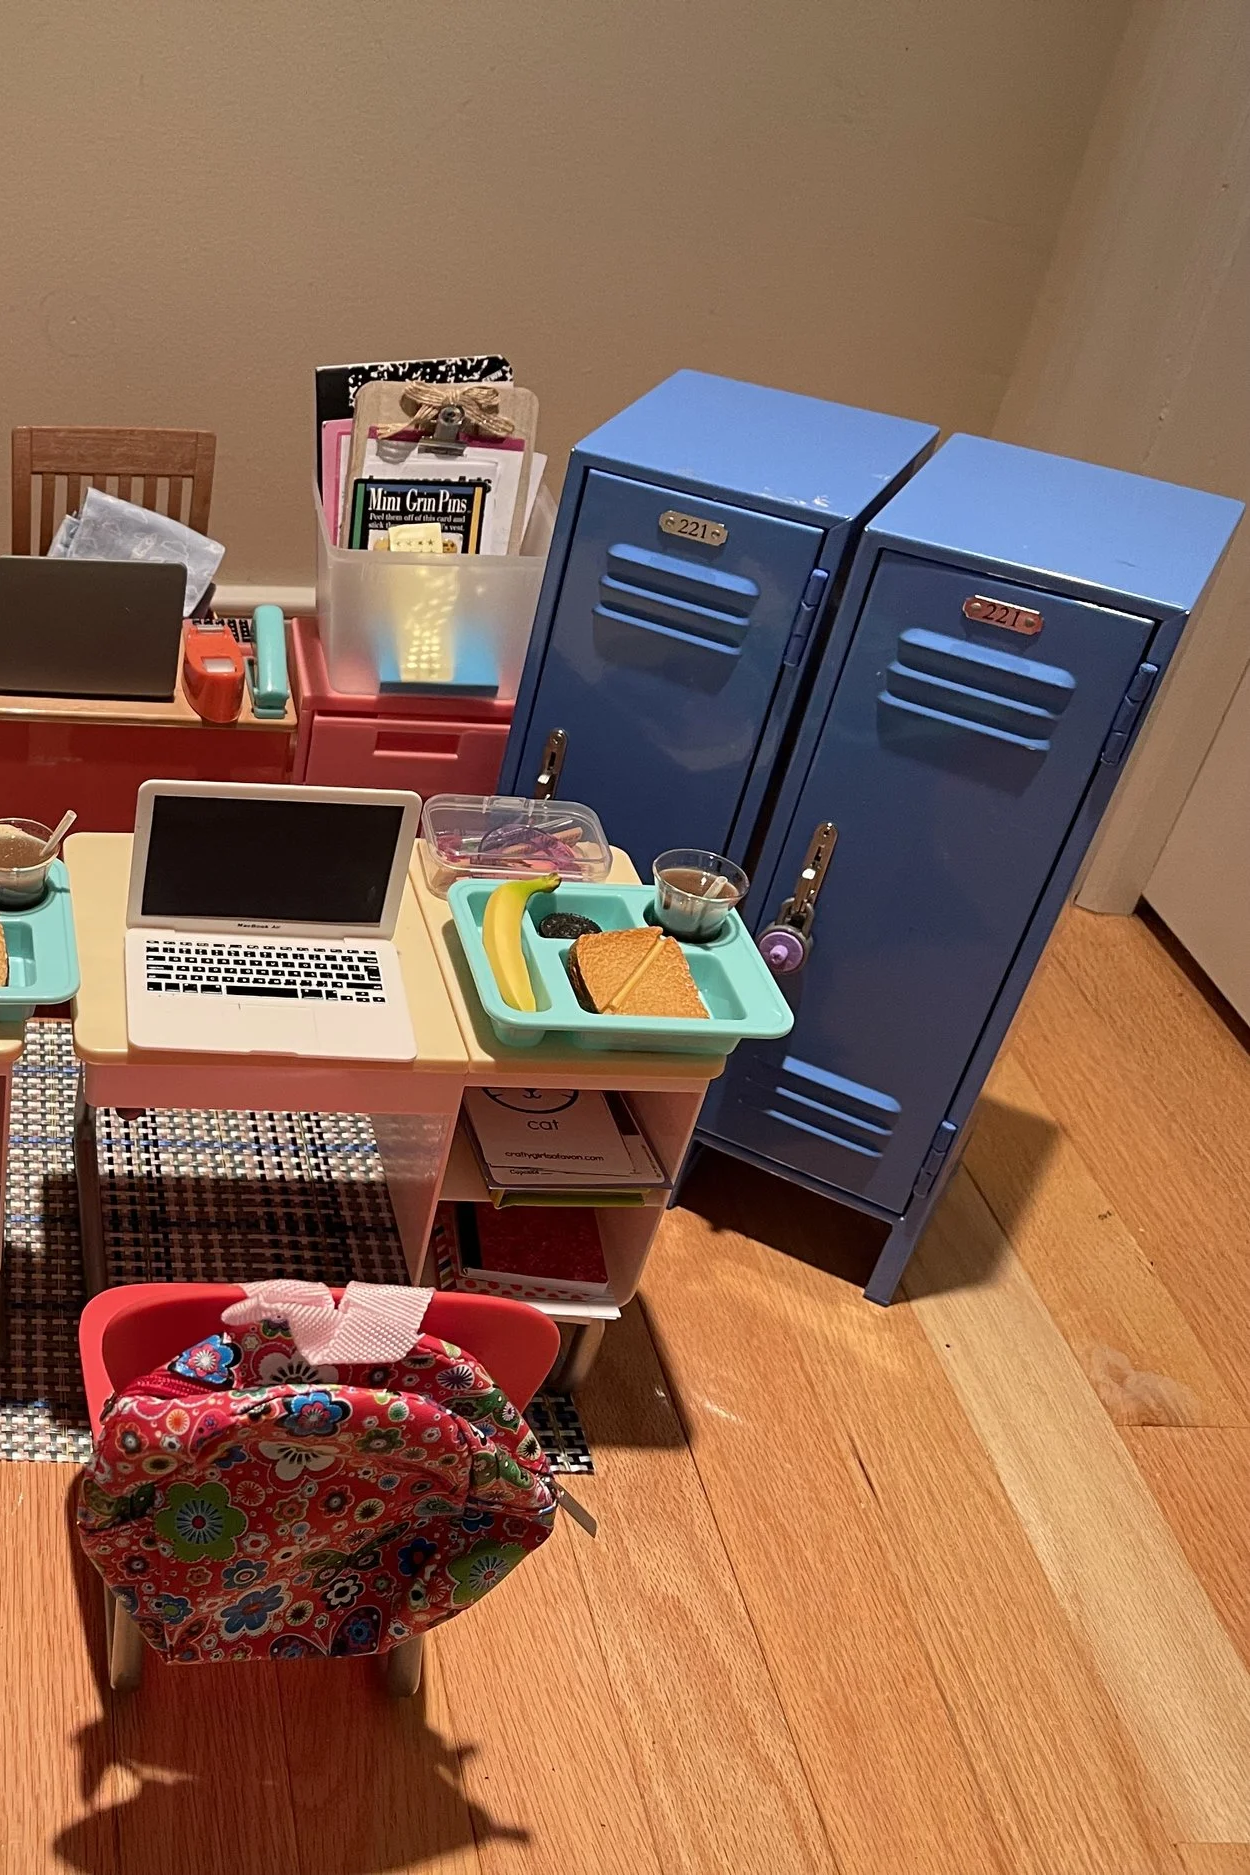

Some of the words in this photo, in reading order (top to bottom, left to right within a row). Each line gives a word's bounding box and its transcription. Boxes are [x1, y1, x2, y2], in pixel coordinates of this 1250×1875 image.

[406, 488, 435, 512] Grin
[438, 489, 468, 514] Pins
[369, 513, 385, 521] Peel
[385, 513, 402, 521] them
[403, 513, 415, 521] off
[423, 514, 435, 522] this
[452, 515, 466, 523] and
[677, 518, 708, 539] 221
[981, 604, 1020, 628] 221
[527, 1119, 559, 1131] cat
[504, 1151, 605, 1162] craftygirlsofavon.com
